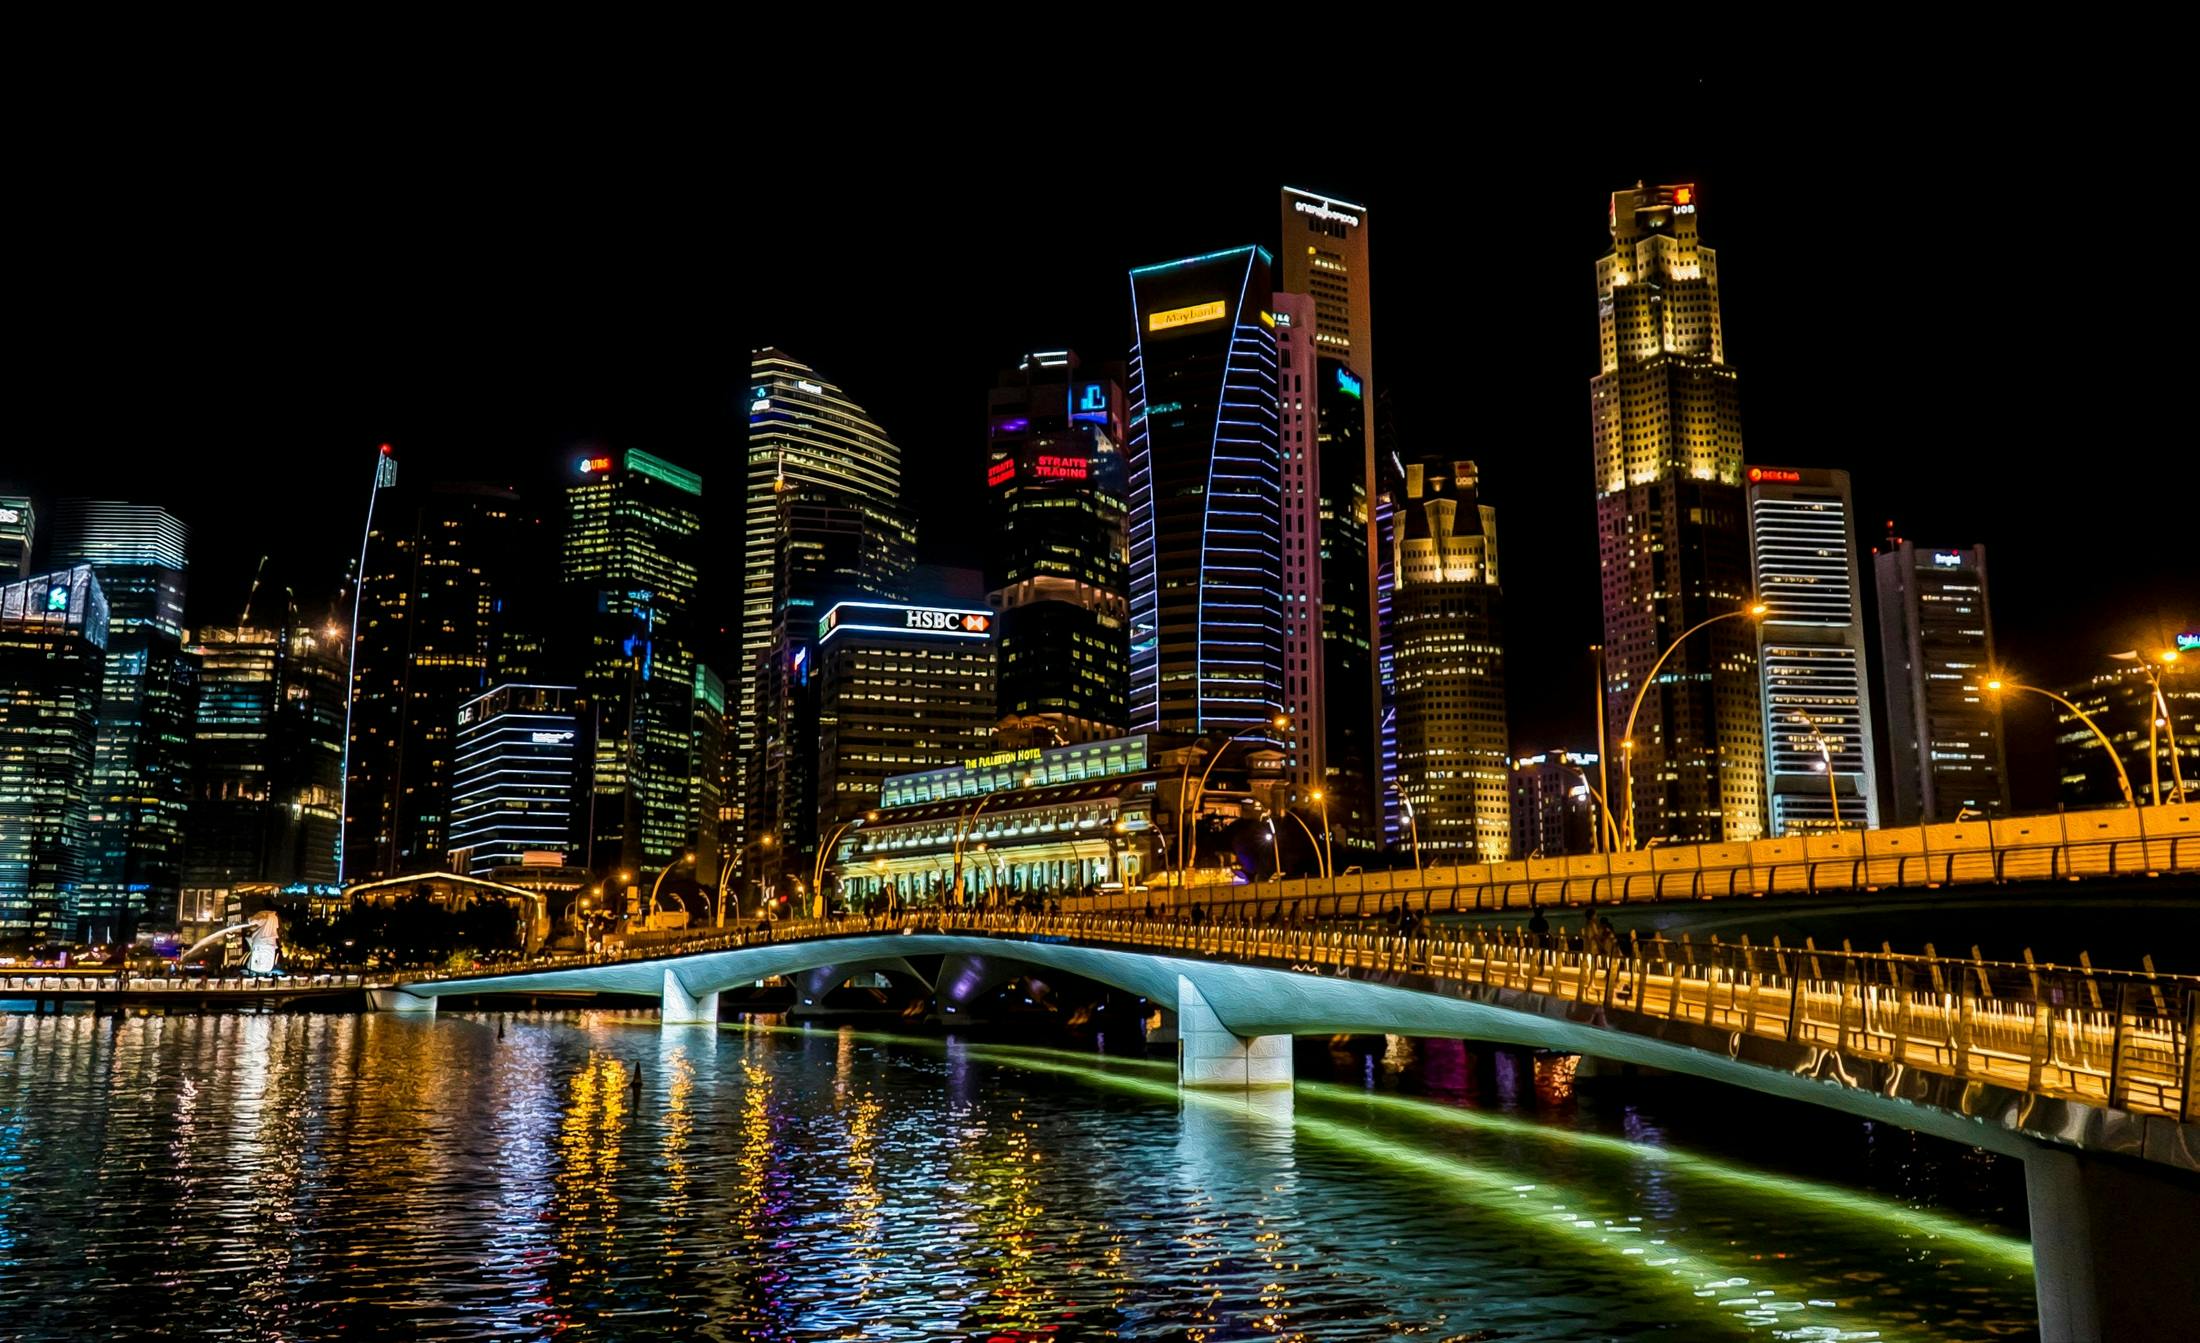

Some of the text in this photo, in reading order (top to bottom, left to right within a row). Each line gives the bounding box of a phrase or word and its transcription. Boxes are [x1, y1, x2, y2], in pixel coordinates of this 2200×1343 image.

[1673, 204, 1695, 214] UOB
[1166, 307, 1218, 324] Maybank
[591, 458, 608, 470] UBS
[1038, 455, 1086, 468] STRAITS
[1036, 466, 1086, 479] TRADING
[906, 610, 960, 630] HSBC
[965, 748, 1041, 769] THE FULLERTON HOTEL
